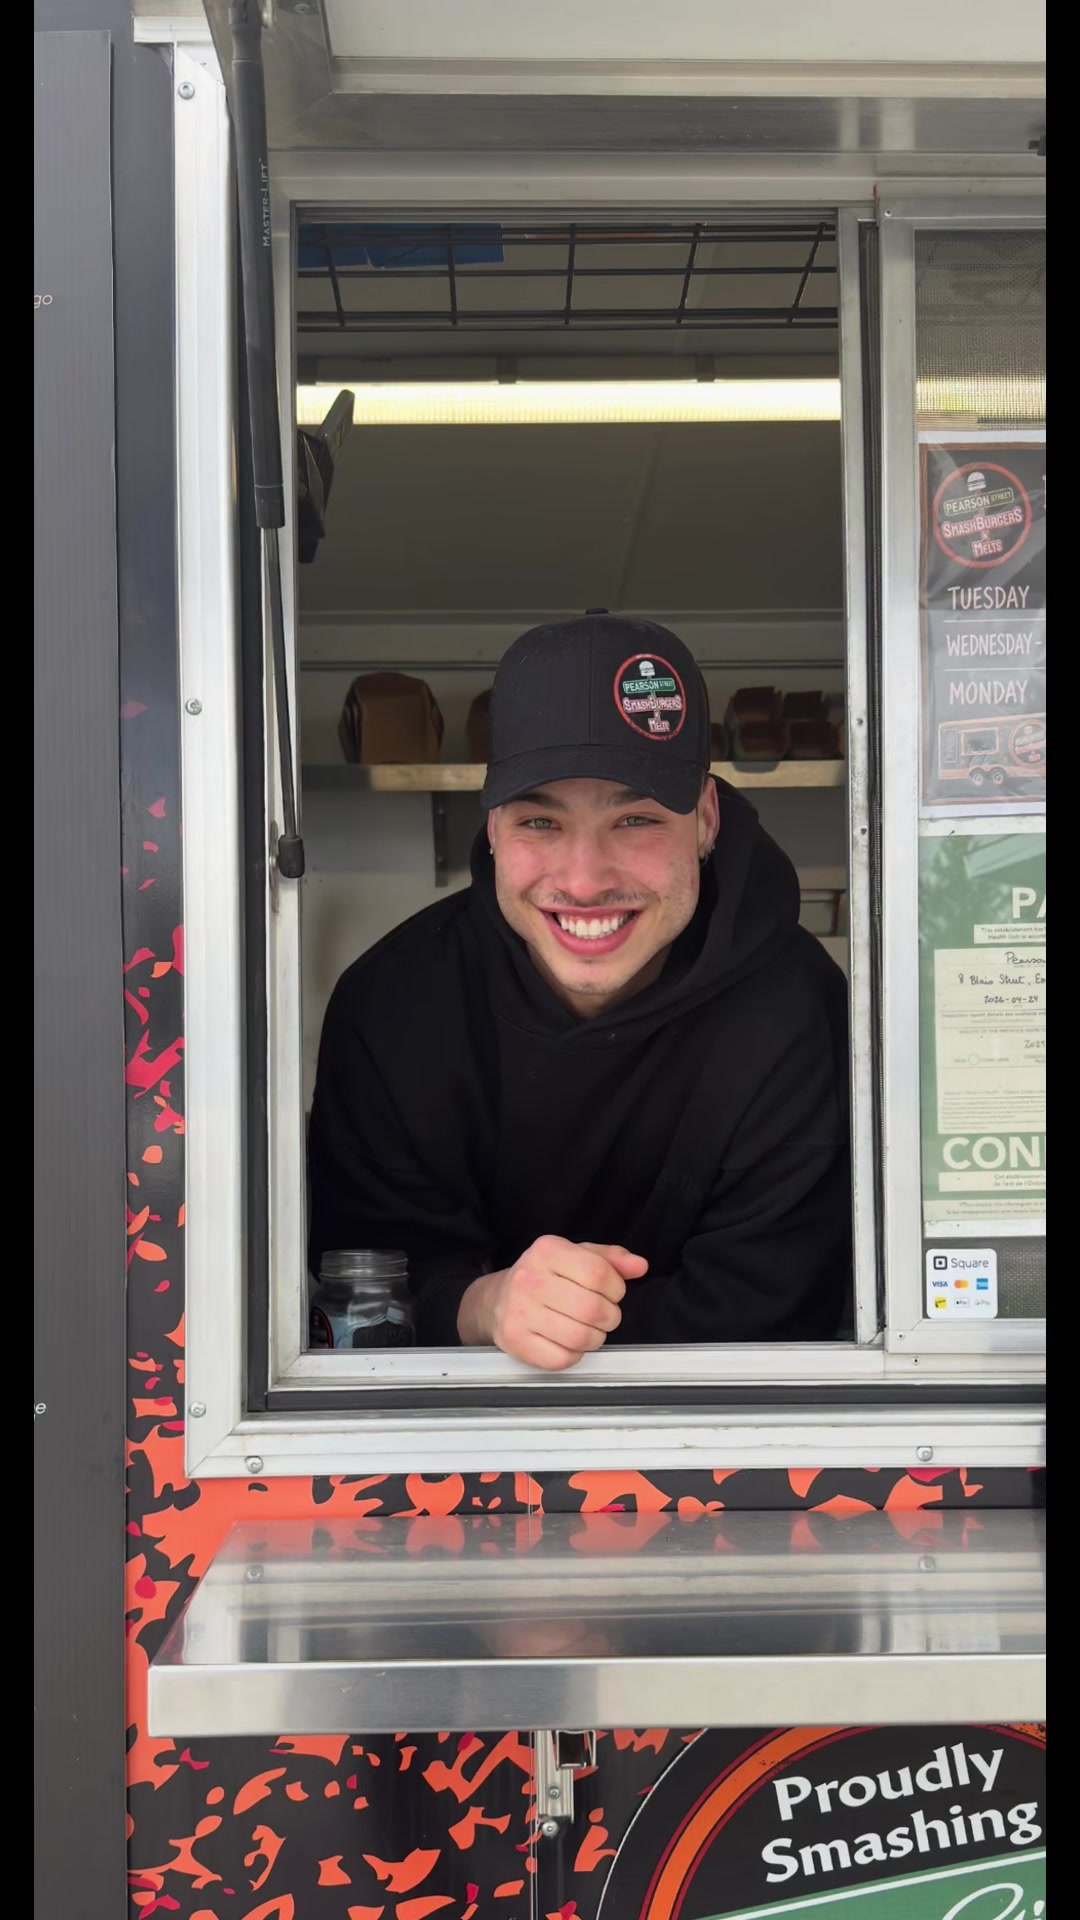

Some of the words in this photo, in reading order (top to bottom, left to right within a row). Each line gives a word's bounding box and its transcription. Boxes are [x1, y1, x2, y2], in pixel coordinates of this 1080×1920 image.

[945, 497, 990, 514] PEARSON
[990, 491, 1012, 502] STREET
[947, 585, 1030, 610] TUESDAY
[624, 681, 659, 691] PEARSON
[950, 680, 1028, 705] MONDAY
[958, 973, 964, 985] 8
[950, 1257, 990, 1270] Square
[772, 1742, 1004, 1821] Proudly
[761, 1801, 1043, 1883] Smashing
